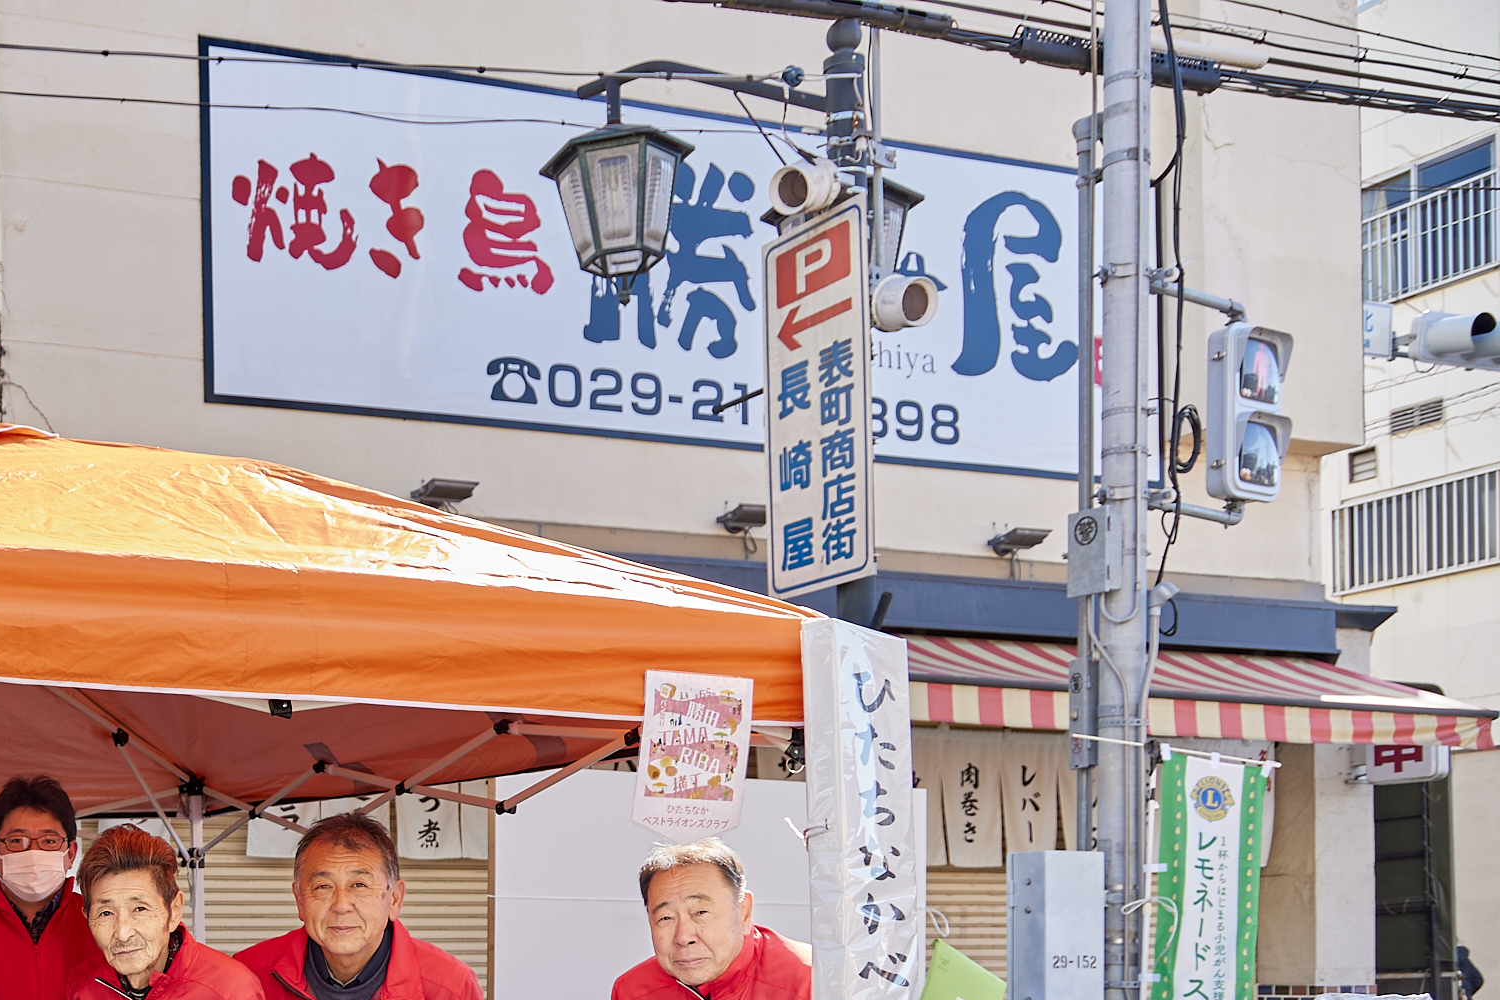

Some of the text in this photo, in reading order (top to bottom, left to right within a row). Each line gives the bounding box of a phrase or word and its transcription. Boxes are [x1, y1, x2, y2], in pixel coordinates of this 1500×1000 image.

[232, 152, 554, 295] 焼き鳥
[795, 237, 832, 295] P
[777, 359, 814, 572] 長崎屋
[818, 337, 857, 566] 表町商店街
[686, 700, 721, 727] 勝田
[658, 726, 709, 746] TAMA
[680, 746, 721, 774] RIBA
[672, 772, 703, 793] 横丁
[666, 803, 710, 815] ひたちなか
[960, 761, 980, 844] 肉巻き
[1019, 763, 1041, 844] レバー
[642, 816, 730, 830] ベストライオンズクラブ
[1052, 954, 1098, 970] 29-152
